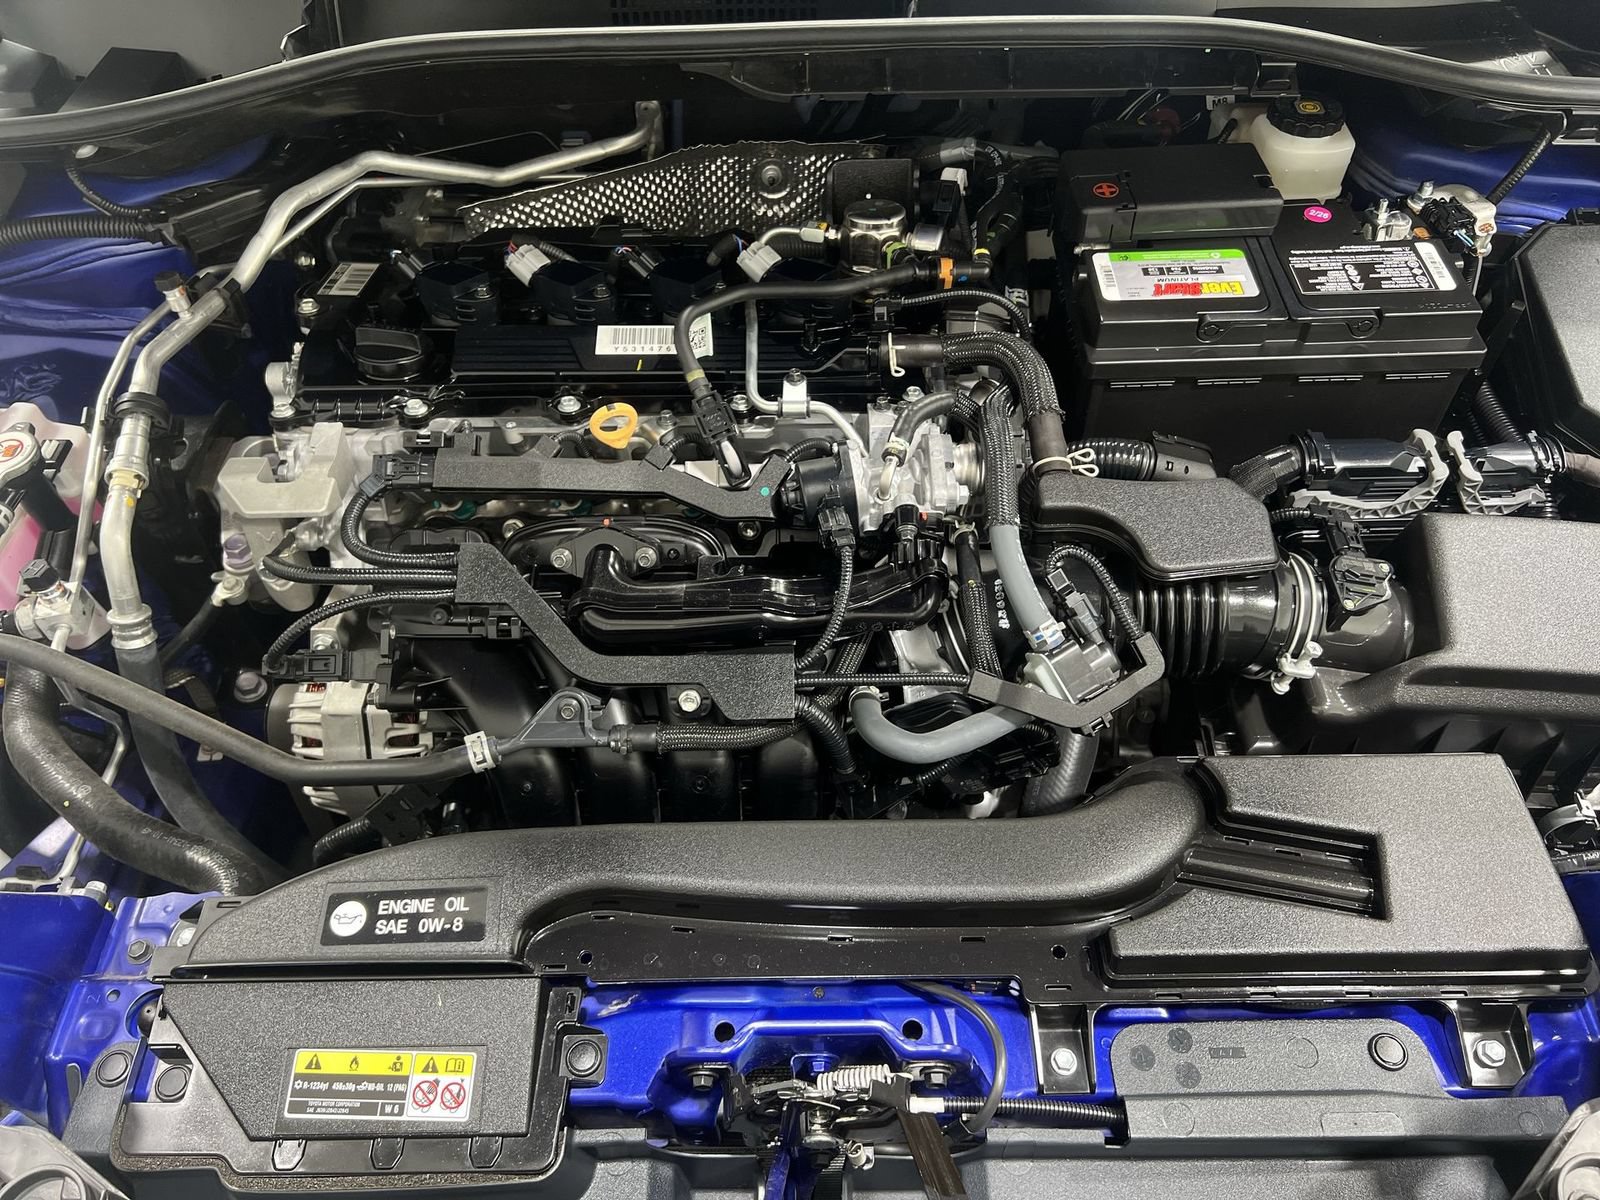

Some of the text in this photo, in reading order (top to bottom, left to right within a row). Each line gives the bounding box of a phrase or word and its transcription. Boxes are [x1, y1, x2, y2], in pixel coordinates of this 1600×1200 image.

[1153, 280, 1244, 297] EverStart
[377, 896, 470, 915] ENGINE OIL
[374, 916, 464, 935] SAE 0W-8
[384, 1104, 400, 1114] W 6
